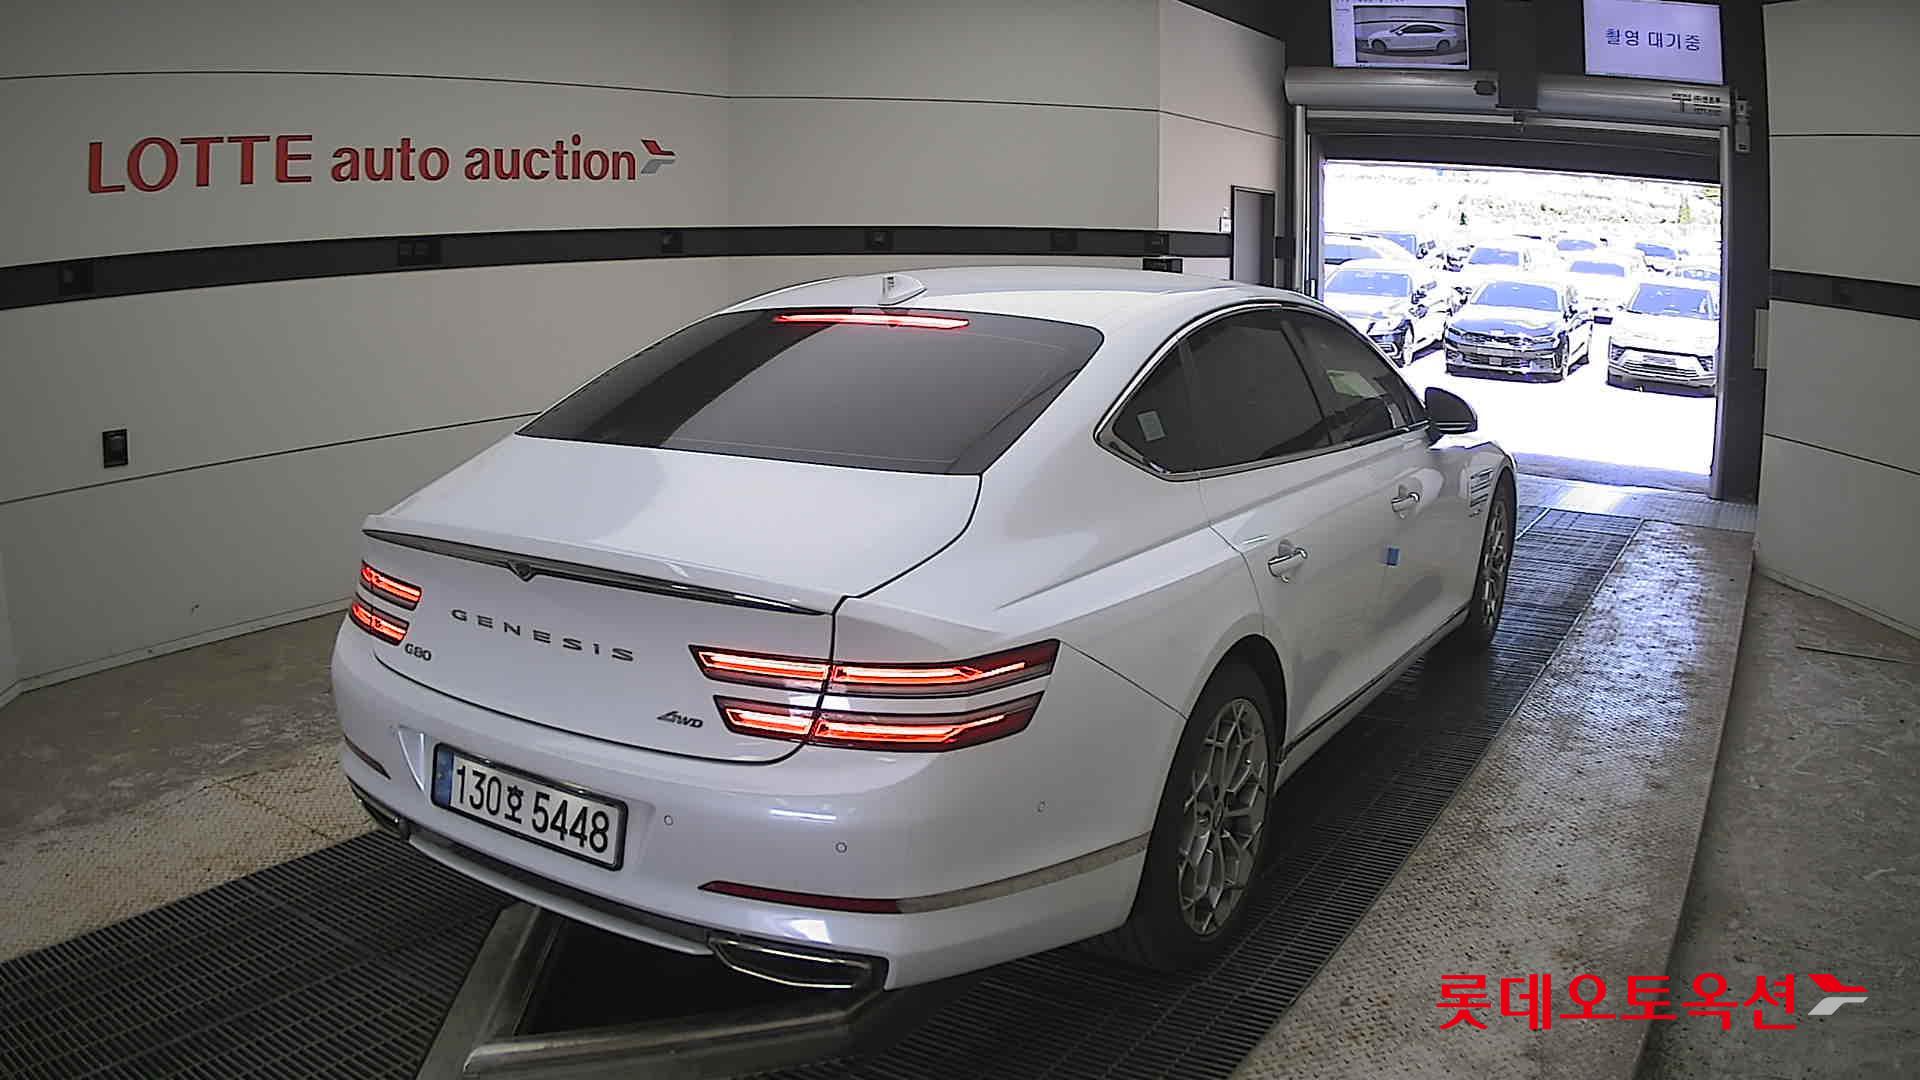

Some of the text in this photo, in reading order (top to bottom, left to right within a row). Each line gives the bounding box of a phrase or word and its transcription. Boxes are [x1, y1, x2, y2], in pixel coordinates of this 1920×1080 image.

[1648, 31, 1701, 51] 대기중
[87, 134, 638, 194] LOTTE auto auction
[404, 643, 432, 661] G80
[451, 609, 635, 662] GENESIS
[531, 791, 610, 853] 5448
